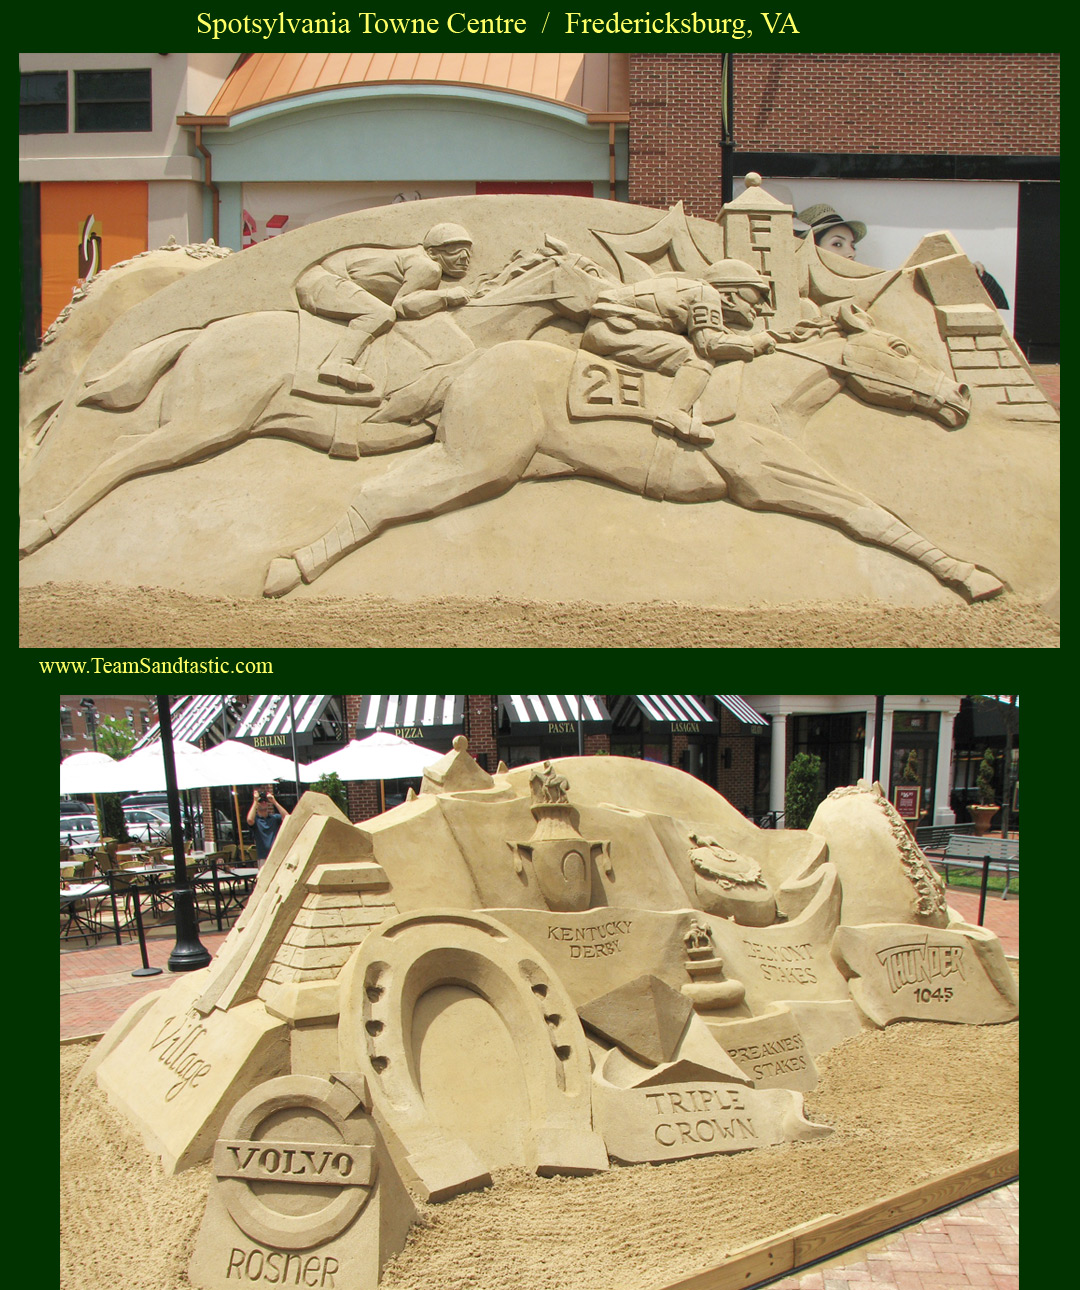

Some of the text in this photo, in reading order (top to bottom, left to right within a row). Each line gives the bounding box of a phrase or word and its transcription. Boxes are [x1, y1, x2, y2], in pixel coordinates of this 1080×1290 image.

[395, 727, 424, 739] PIZZA
[548, 722, 575, 733] PASTA
[671, 722, 700, 733] LASAGNA
[253, 735, 287, 748] BELLINI
[548, 920, 632, 941] KENTUCKY
[569, 940, 622, 958] DERBY
[759, 963, 818, 985] STAKES
[876, 934, 965, 993] THUNDER
[149, 1015, 212, 1102] Village
[753, 1056, 806, 1080] STAKES
[645, 1090, 745, 1115] TRIPLE
[654, 1118, 759, 1147] CROWN
[226, 1146, 354, 1178] VOLVO
